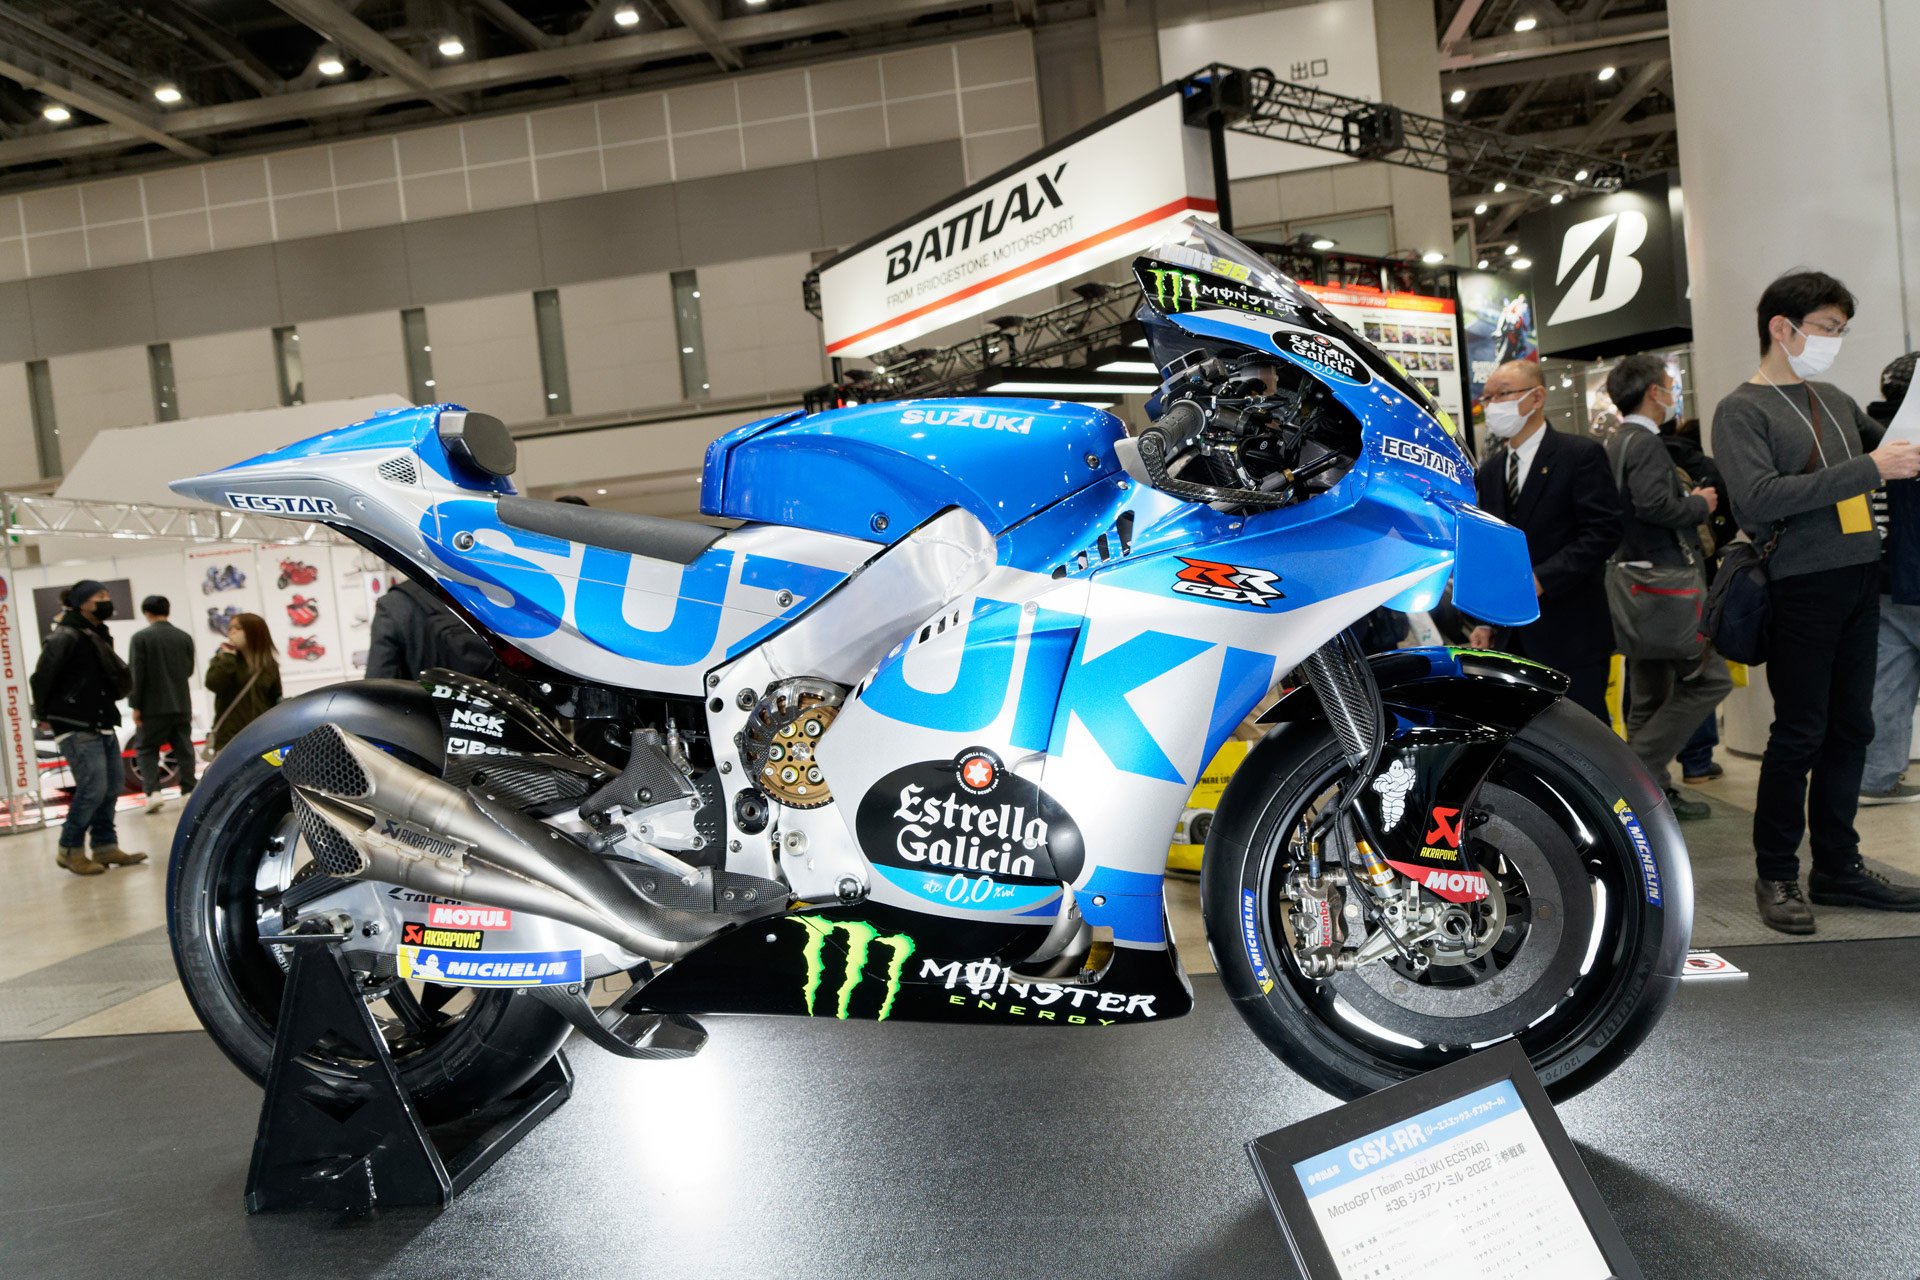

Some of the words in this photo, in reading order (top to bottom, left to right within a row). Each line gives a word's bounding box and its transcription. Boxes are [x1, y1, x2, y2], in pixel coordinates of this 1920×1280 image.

[1290, 58, 1328, 81] 出口
[885, 161, 1068, 285] BATTLAX
[886, 285, 914, 310] FROM
[916, 256, 991, 297] BRIDGESTONE
[992, 215, 1076, 264] MOTORSPORT
[1202, 284, 1299, 317] MONSTER
[1217, 300, 1288, 318] ENERGY
[1288, 334, 1356, 368] Estrella
[1291, 343, 1354, 377] Galicia
[900, 409, 1035, 435] SUZUKI
[1382, 436, 1461, 484] ECSTAR
[226, 493, 350, 519] ECSTAR
[1173, 556, 1286, 598] RR
[1171, 581, 1271, 607] GSX
[0, 603, 14, 680] Sakuma
[7, 685, 28, 788] Engineering
[450, 722, 476, 732] SPARK
[477, 727, 503, 738] PLUGS
[451, 708, 505, 732] NGK
[893, 783, 1049, 850] Estrella
[399, 827, 457, 859] AKRAPOVIČ
[896, 824, 1036, 878] Galicia
[1420, 846, 1458, 861] AKRAPOVIČ
[1628, 825, 1660, 900] MICHELIN
[945, 873, 994, 904] 0,0
[1424, 871, 1490, 895] MOTUL
[433, 907, 508, 927] MOTUL
[1244, 895, 1263, 967] MICHELIN
[1320, 900, 1331, 946] brembo
[423, 930, 481, 950] AKRAPOVIČ
[446, 961, 568, 977] MICHELIN
[919, 957, 1158, 1018] MONSTER
[948, 995, 1116, 1027] ENERGY
[1545, 1055, 1580, 1081] 120/70
[1348, 1123, 1428, 1171] GSX-RR
[1404, 1159, 1446, 1185] SUZUKI
[1385, 1195, 1408, 1213] #36
[1409, 1170, 1464, 1203] ジョアン・ミル
